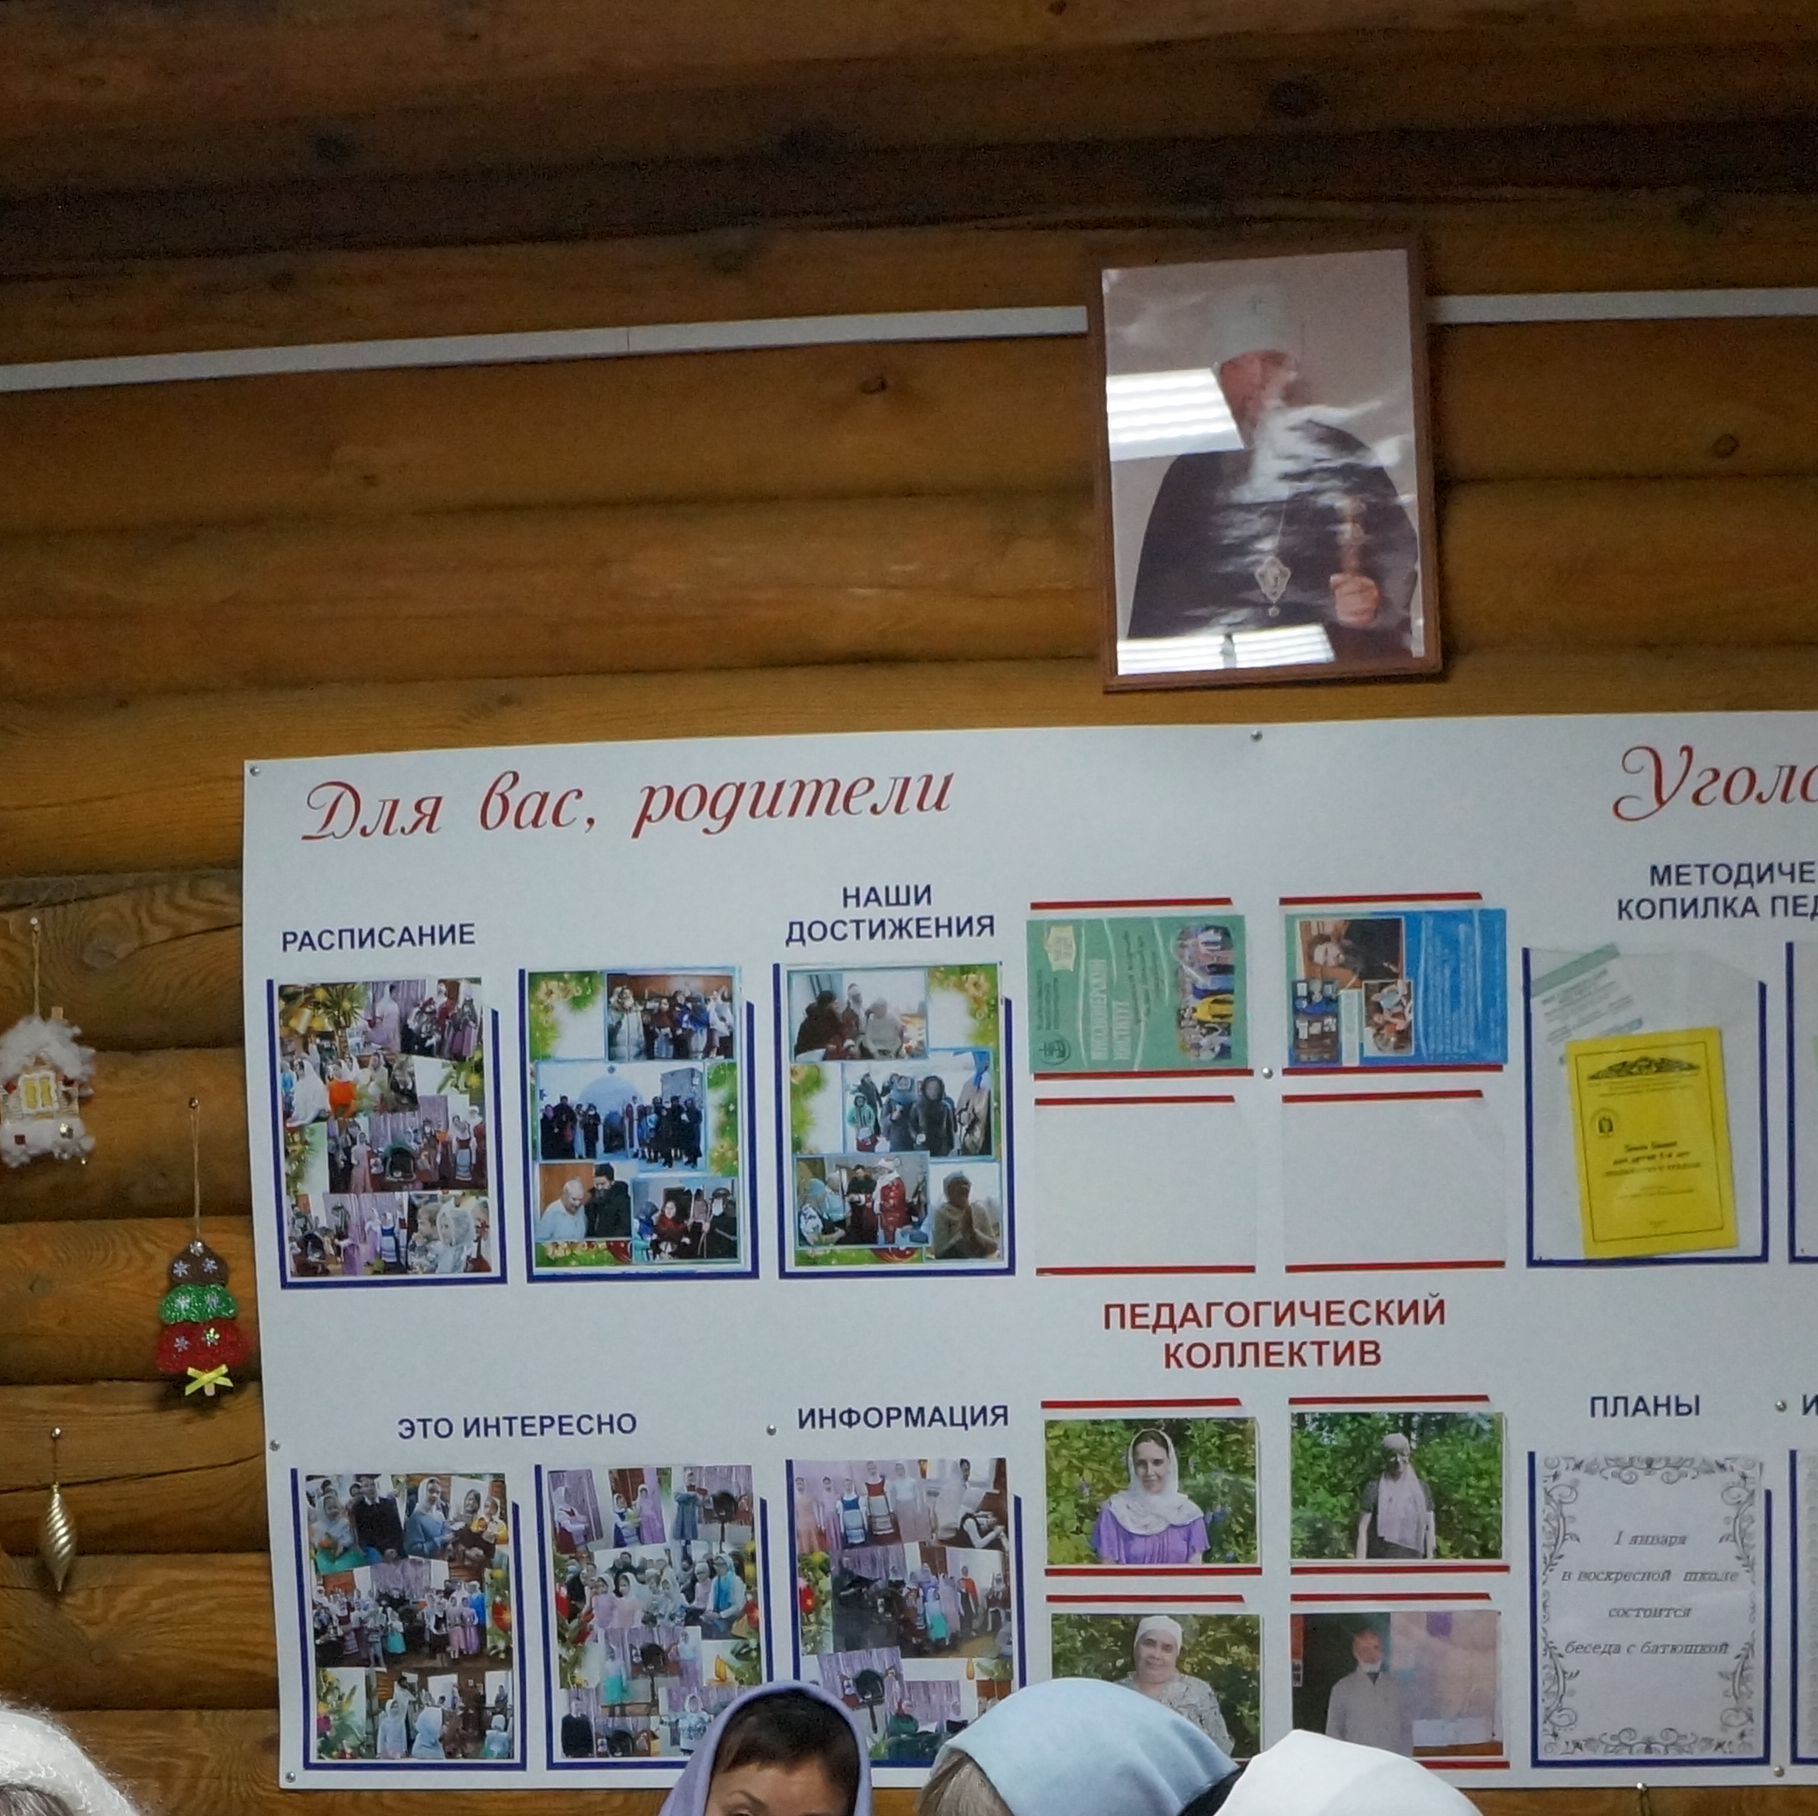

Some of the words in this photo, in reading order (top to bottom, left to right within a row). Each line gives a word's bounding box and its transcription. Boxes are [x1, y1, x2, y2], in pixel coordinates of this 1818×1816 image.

[301, 780, 443, 841] Для
[480, 770, 595, 834] вас,
[631, 773, 956, 839] родители
[842, 884, 932, 909] НАШИ
[1617, 895, 1760, 921] КОПИЛКА
[282, 923, 476, 953] РАСПИСАНИЕ
[785, 914, 995, 947] ДОСТИЖЕНИЯ
[1104, 1292, 1445, 1335] ПЕДАГОГИЧЕСКИЙ
[1164, 1340, 1382, 1369] КОЛЛЕКТИВ
[798, 1404, 1009, 1431] ИНФОРМАЦИЯ
[1590, 1394, 1700, 1418] ПЛАНЫ
[398, 1417, 454, 1440] ЭТО
[463, 1412, 637, 1439] ИНТЕРЕСНО
[1614, 1531, 1623, 1545] 1
[1629, 1535, 1687, 1547] января
[1561, 1571, 1572, 1581] в
[1577, 1569, 1671, 1584] воскресной
[1684, 1571, 1739, 1582] школе
[1608, 1608, 1692, 1618] состоится
[1565, 1641, 1620, 1656] беседа
[1627, 1644, 1635, 1653] с
[1640, 1641, 1729, 1654] батюшкой
